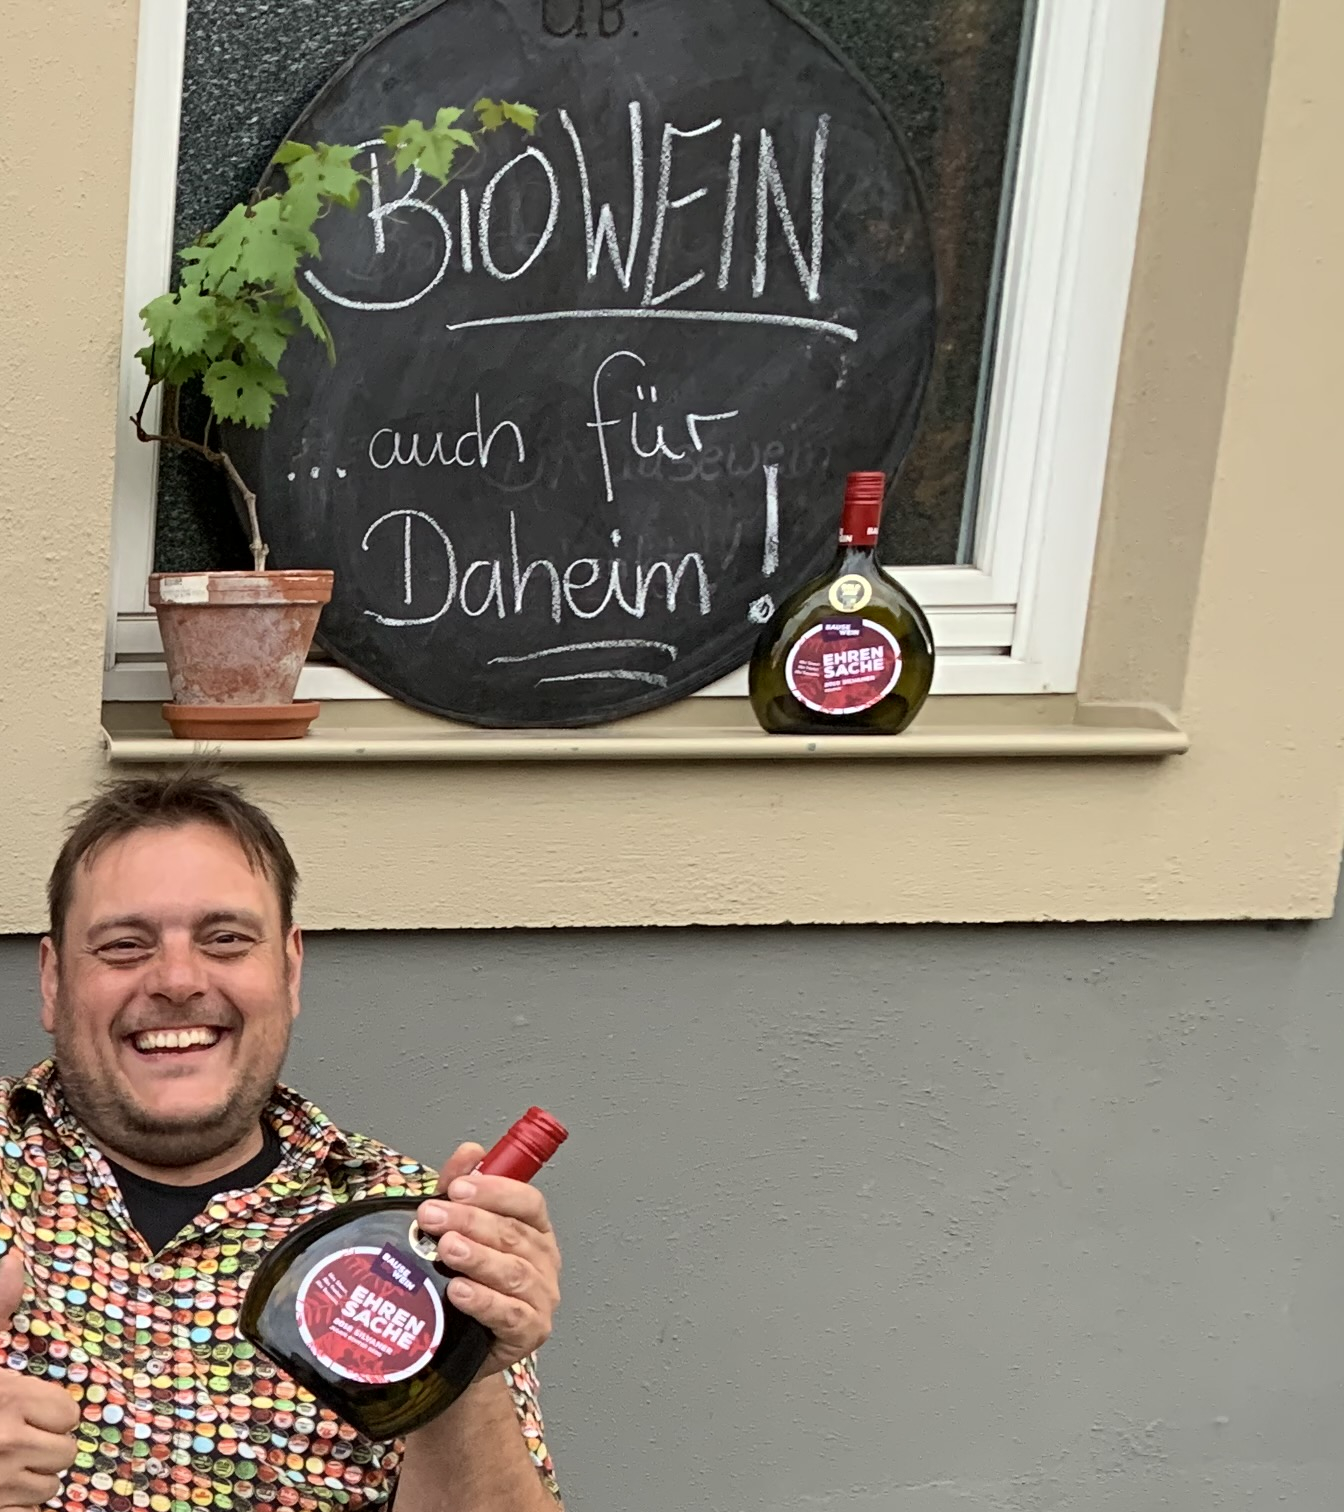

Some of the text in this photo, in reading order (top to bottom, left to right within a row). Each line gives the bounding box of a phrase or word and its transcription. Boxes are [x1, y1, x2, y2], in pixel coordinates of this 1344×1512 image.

[586, 350, 741, 502] für
[825, 623, 852, 631] BAUSE
[822, 645, 885, 667] EHREN
[823, 658, 885, 679] SACHE
[381, 1252, 412, 1279] BAUSE
[390, 1269, 416, 1292] WEIN
[349, 1284, 426, 1337] EHREN
[340, 1301, 418, 1350] SACHE
